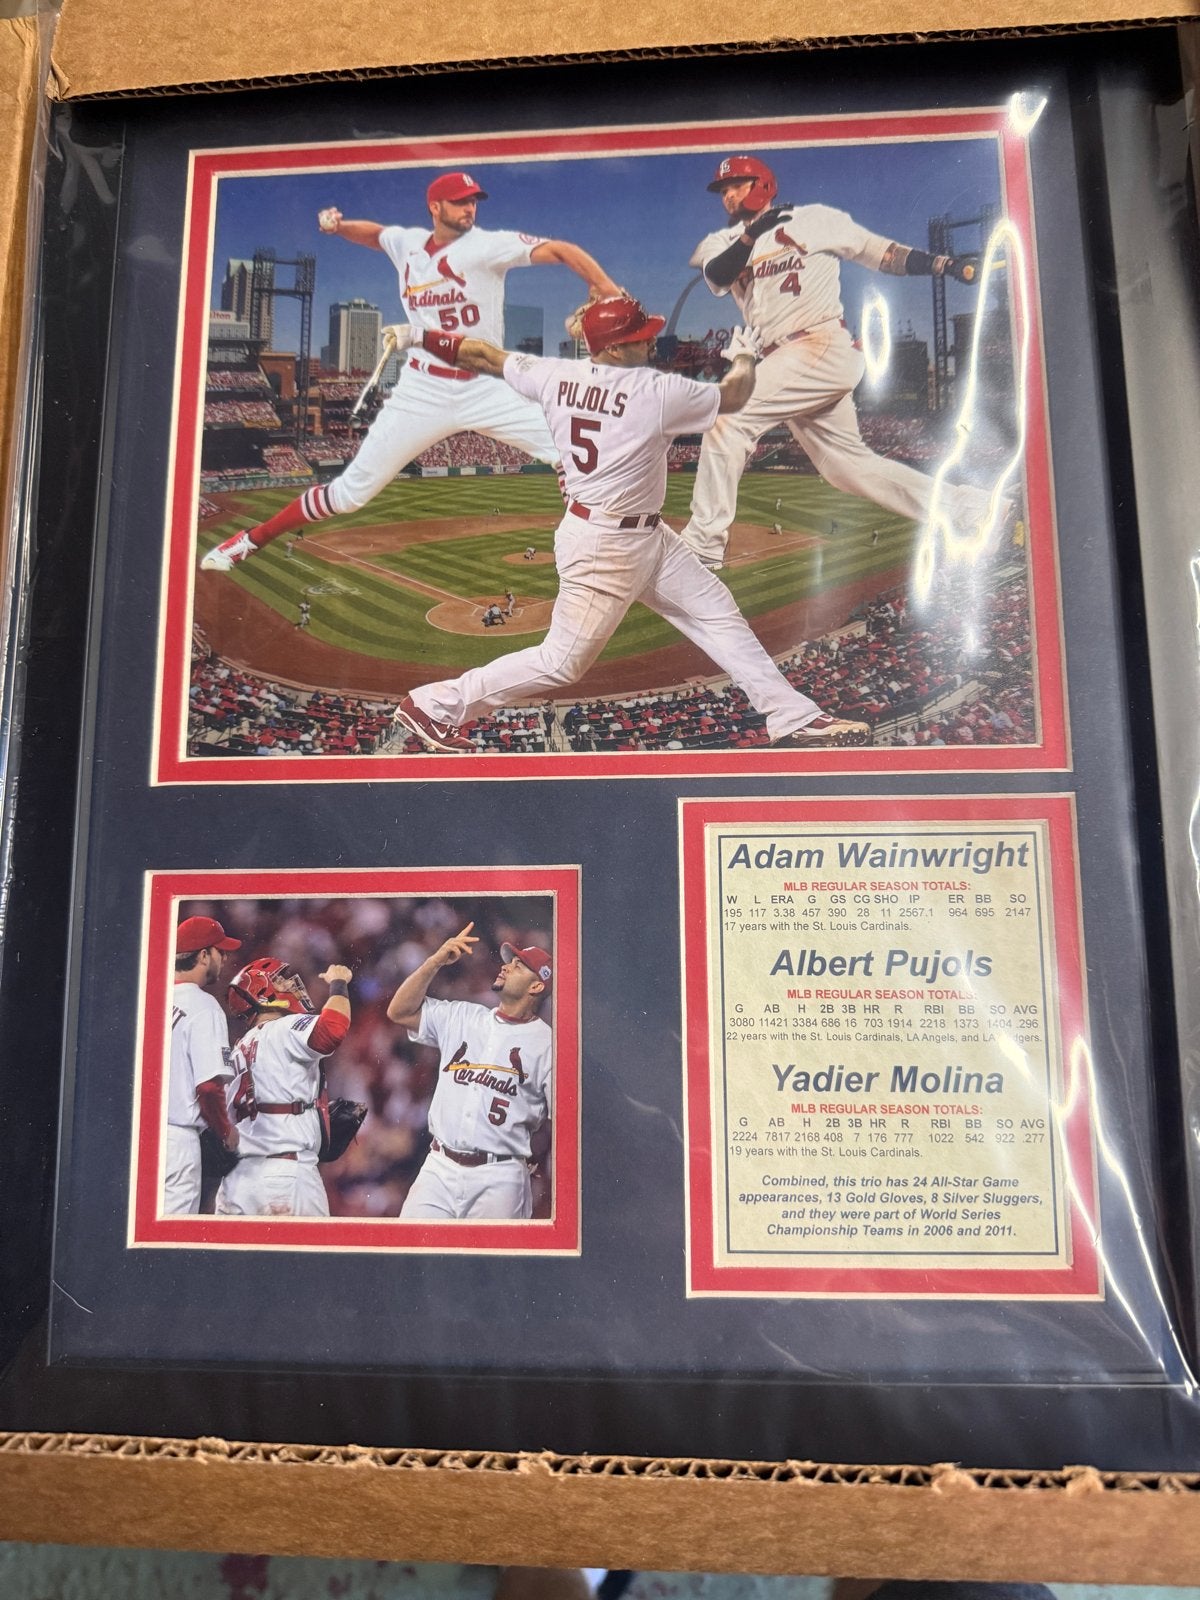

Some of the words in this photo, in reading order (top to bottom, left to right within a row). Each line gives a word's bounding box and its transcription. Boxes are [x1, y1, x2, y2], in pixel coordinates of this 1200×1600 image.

[780, 272, 801, 296] 4
[439, 304, 480, 331] 50
[558, 381, 628, 418] PUJOLS
[571, 415, 601, 474] 5
[728, 843, 824, 869] Adam
[838, 841, 1029, 873] Wainwright
[784, 882, 808, 891] MLB
[811, 882, 867, 891] REGULAR
[870, 882, 918, 891] SEASON
[922, 881, 971, 890] TOTALS:
[727, 895, 738, 903] W
[754, 895, 761, 903] L
[771, 895, 794, 903] ERA
[808, 895, 816, 904] G
[830, 895, 846, 904] GS
[853, 895, 870, 904] CG
[874, 895, 898, 903] SHO
[909, 895, 920, 903] IP
[948, 894, 964, 903] ER
[975, 894, 991, 903] BB
[1010, 894, 1027, 903] SO
[724, 909, 742, 918] 195
[750, 909, 766, 917] 117
[773, 909, 795, 917] 3.38
[802, 909, 821, 917] 457
[828, 908, 847, 917] 390
[857, 908, 870, 917] 28
[881, 908, 891, 917] 11
[899, 908, 933, 917] 2567.1
[949, 908, 967, 917] 964
[975, 908, 994, 917] 695
[1005, 908, 1031, 917] 2147
[724, 922, 735, 930] 17
[740, 923, 767, 933] years
[770, 922, 790, 930] with
[793, 922, 809, 930] the
[812, 922, 825, 930] St.
[830, 922, 857, 930] Louis
[860, 921, 912, 930] Cardinals.
[770, 950, 873, 976] Albert
[885, 951, 992, 983] Pujols
[787, 989, 812, 999] MLB
[815, 989, 871, 999] REGULAR
[875, 990, 924, 1000] SEASON
[928, 990, 978, 1000] TOTALS:
[735, 1004, 743, 1013] G
[764, 1004, 780, 1013] AB
[798, 1004, 806, 1013] H
[820, 1004, 834, 1013] 2B
[842, 1004, 856, 1013] 3B
[864, 1005, 880, 1013] HR
[895, 1004, 903, 1014] R
[925, 1005, 944, 1014] RBI
[959, 1005, 975, 1014] BB
[990, 1005, 1006, 1014] SO
[1013, 1005, 1037, 1014] AVG
[730, 1018, 755, 1027] 3080
[760, 1018, 788, 1027] 11421
[792, 1018, 817, 1027] 3384
[821, 1018, 840, 1027] 686
[845, 1018, 857, 1027] 16
[864, 1018, 883, 1027] 703
[888, 1018, 912, 1028] 1914
[920, 1019, 945, 1028] 2218
[955, 1019, 979, 1028] 1373
[1016, 1019, 1038, 1028] .296
[726, 1032, 737, 1040] 22
[741, 1033, 767, 1042] years
[770, 1032, 788, 1040] with
[792, 1032, 806, 1041] the
[810, 1032, 822, 1041] St.
[827, 1032, 851, 1041] Louis
[855, 1032, 903, 1043] Cardinals,
[906, 1033, 919, 1041] LA
[922, 1033, 957, 1043] Angels,
[961, 1033, 978, 1041] and
[983, 1033, 996, 1041] LA
[454, 1060, 517, 1096] Cardinals
[772, 1064, 879, 1092] Yadier
[890, 1066, 1003, 1093] Molina
[488, 1096, 510, 1126] 5
[791, 1104, 816, 1113] MLB
[820, 1104, 877, 1114] REGULAR
[880, 1104, 929, 1114] SEASON
[933, 1105, 983, 1114] TOTALS:
[739, 1117, 748, 1126] G
[768, 1118, 785, 1127] AB
[803, 1118, 811, 1127] H
[825, 1118, 840, 1127] 2B
[848, 1118, 862, 1128] 3B
[870, 1119, 886, 1128] HR
[901, 1119, 909, 1128] R
[931, 1119, 950, 1128] RBI
[966, 1119, 982, 1128] BB
[997, 1119, 1013, 1129] SO
[1020, 1119, 1044, 1128] AVG
[732, 1132, 757, 1141] 2224
[765, 1132, 790, 1141] 7817
[794, 1132, 820, 1141] 2168
[823, 1132, 843, 1142] 408
[854, 1133, 860, 1142] 7
[868, 1133, 887, 1142] 176
[894, 1133, 913, 1142] 777
[928, 1133, 954, 1143] 1022
[965, 1134, 984, 1143] 542
[995, 1134, 1015, 1143] 922
[1022, 1134, 1044, 1143] .277
[730, 1146, 742, 1155] 19
[745, 1147, 773, 1158] years
[776, 1146, 798, 1156] with
[801, 1147, 817, 1156] the
[821, 1147, 835, 1157] St.
[839, 1147, 866, 1157] Louis
[870, 1147, 923, 1157] Cardinals.
[762, 1175, 829, 1188] Combined,
[833, 1176, 856, 1187] this
[860, 1176, 882, 1187] trio
[886, 1176, 909, 1187] has
[913, 1177, 927, 1187] 24
[931, 1176, 979, 1187] All-Star
[982, 1177, 1019, 1187] Game
[739, 1192, 822, 1204] appearances,
[827, 1192, 841, 1203] 13
[846, 1192, 876, 1203] Gold
[880, 1192, 927, 1205] Gloves,
[931, 1193, 938, 1203] 8
[942, 1193, 979, 1204] Silver
[983, 1193, 1043, 1206] Sluggers,
[781, 1209, 805, 1219] and
[809, 1209, 836, 1221] they
[840, 1210, 870, 1219] were
[874, 1210, 900, 1222] part
[903, 1209, 917, 1219] of
[920, 1209, 957, 1220] World
[961, 1209, 1001, 1220] Series
[767, 1224, 858, 1238] Championship
[863, 1225, 903, 1236] Teams
[907, 1225, 919, 1236] in
[924, 1225, 953, 1236] 2006
[957, 1226, 981, 1236] and
[985, 1225, 1016, 1236] 2011.
